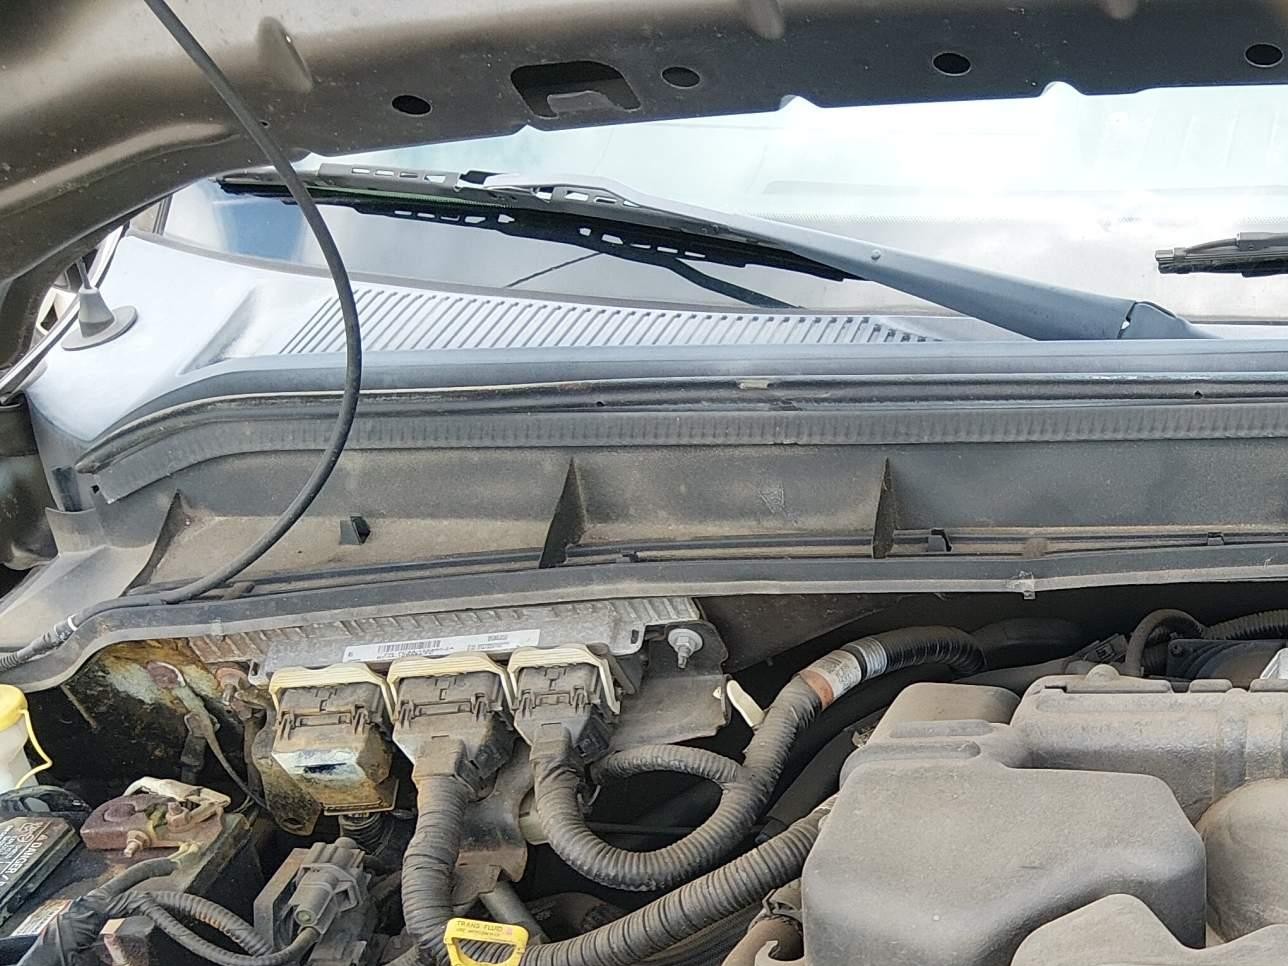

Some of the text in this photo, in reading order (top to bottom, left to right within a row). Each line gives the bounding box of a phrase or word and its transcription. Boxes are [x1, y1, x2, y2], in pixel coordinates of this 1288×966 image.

[5, 842, 43, 874] DANGER
[456, 920, 480, 929] TRANS
[483, 924, 503, 932] FLUID
